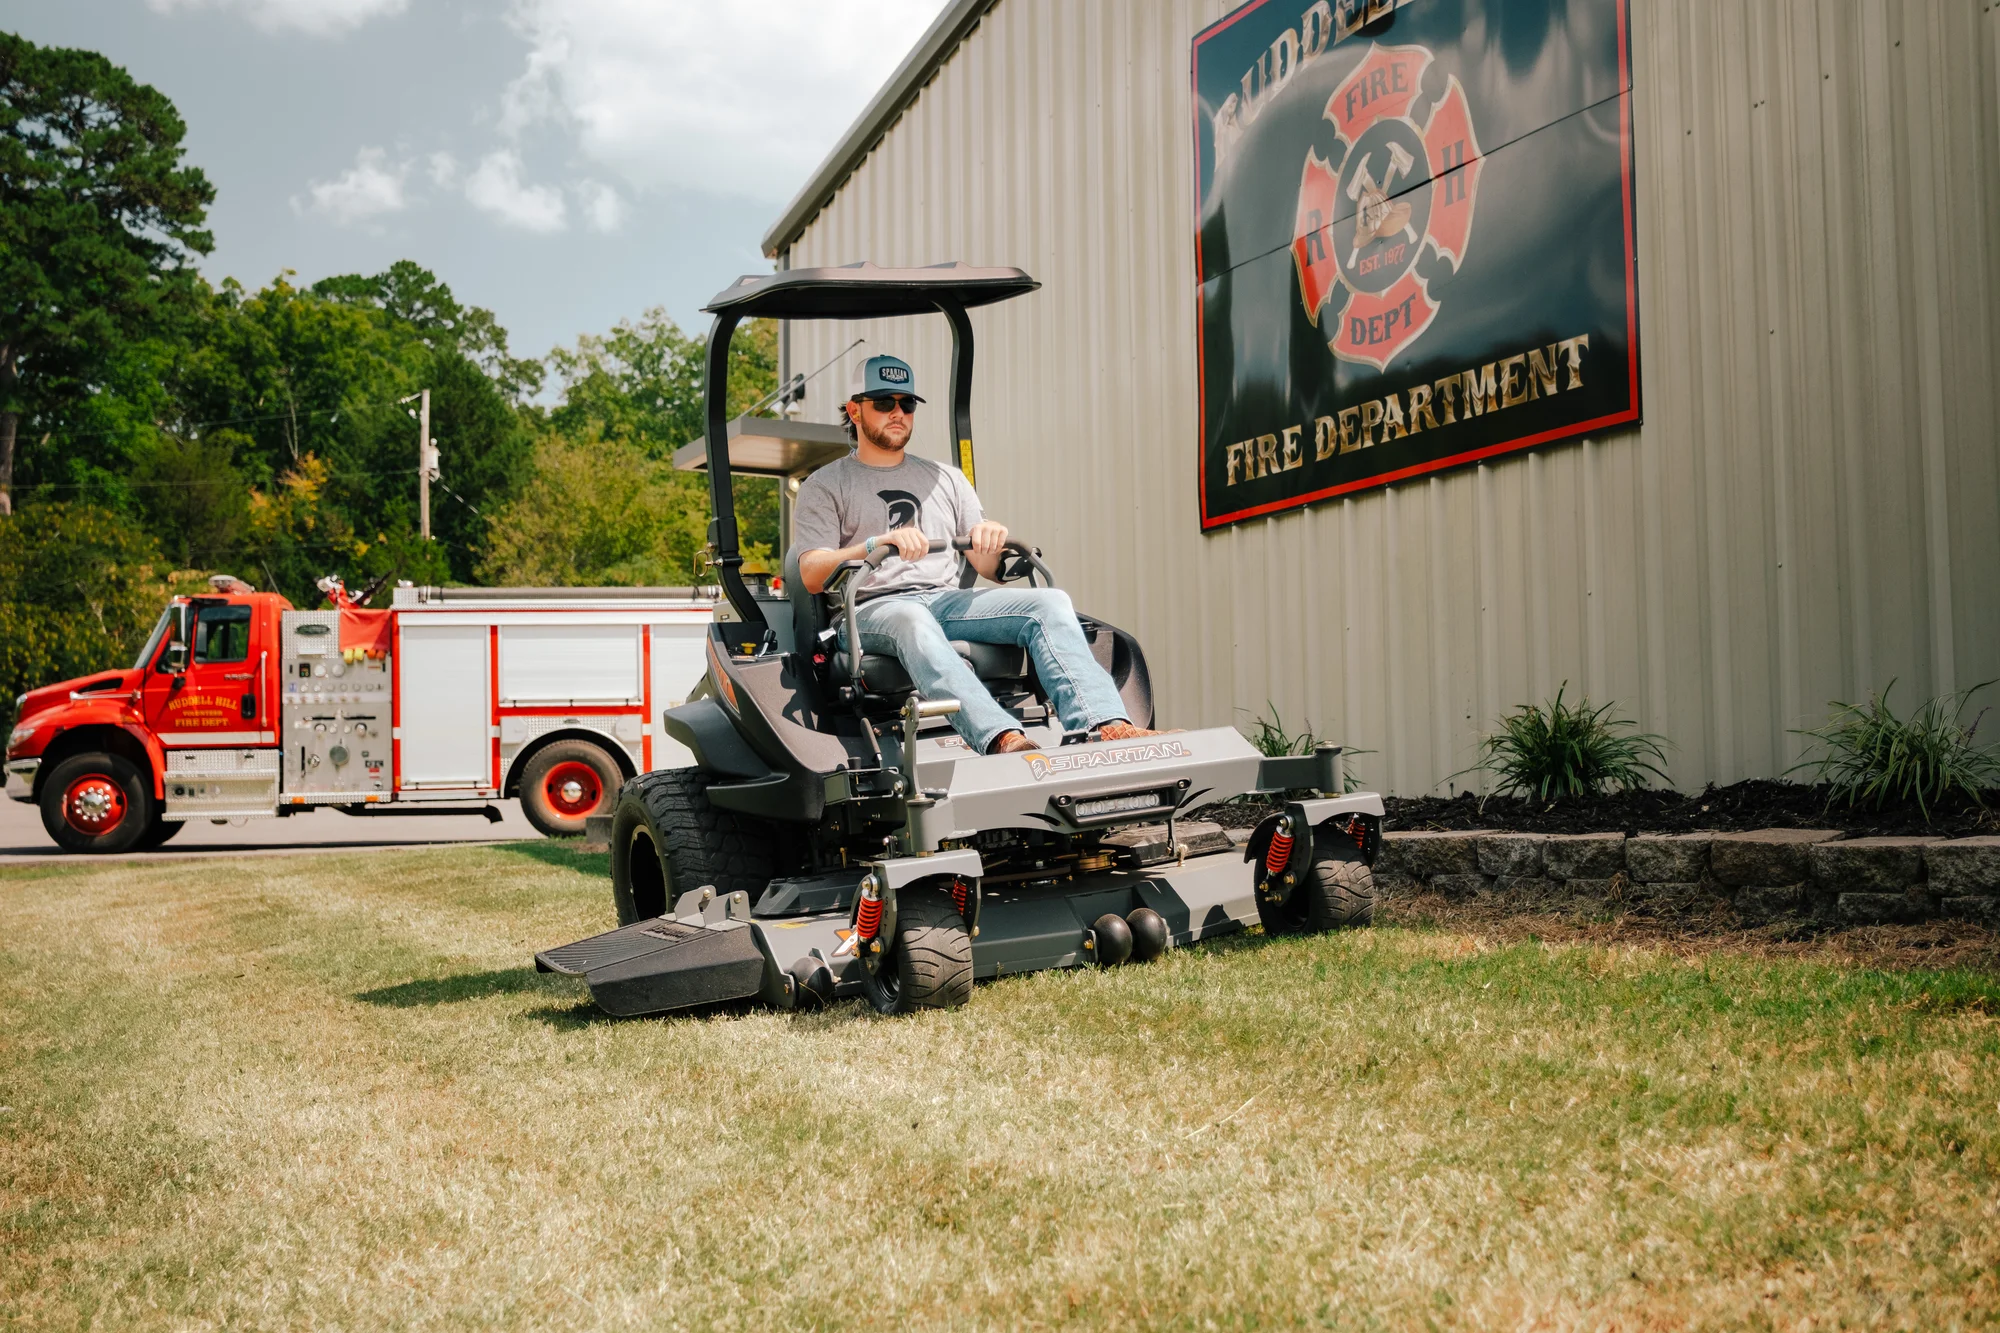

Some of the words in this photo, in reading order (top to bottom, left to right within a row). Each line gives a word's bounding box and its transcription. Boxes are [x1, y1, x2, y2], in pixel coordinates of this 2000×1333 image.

[1345, 62, 1409, 123] FIRE
[1441, 139, 1466, 207] H
[1305, 208, 1326, 267] R
[1359, 254, 1380, 276] EST.
[1384, 243, 1405, 266] 1977
[1350, 293, 1416, 345] DEPT
[881, 368, 907, 379] SPARTAN
[1226, 425, 1303, 487] FIRE
[1314, 333, 1589, 462] DEPARTMENT
[175, 718, 199, 727] FIRE
[215, 696, 238, 710] HILL
[1049, 743, 1183, 771] SPARTAN
